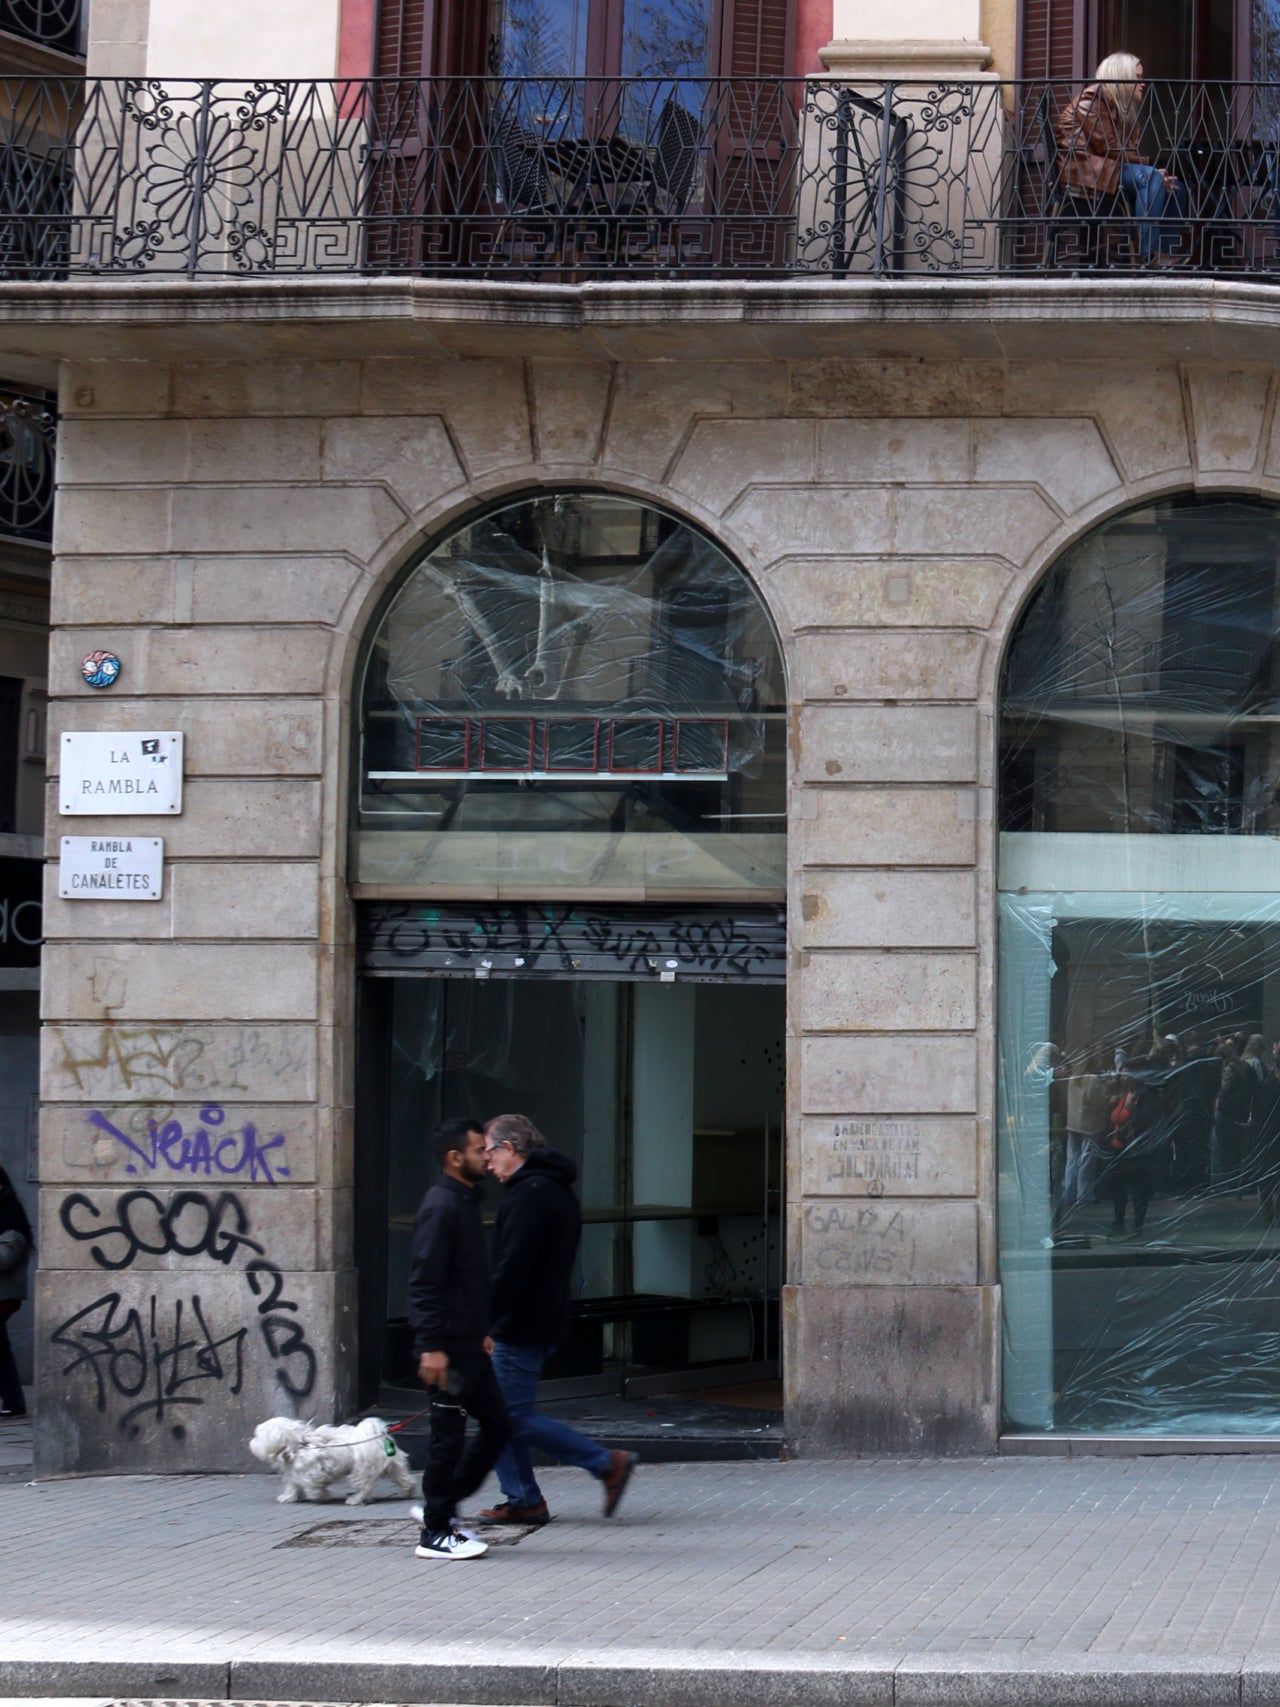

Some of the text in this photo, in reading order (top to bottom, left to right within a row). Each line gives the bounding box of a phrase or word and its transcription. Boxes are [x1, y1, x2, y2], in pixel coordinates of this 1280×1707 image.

[110, 751, 130, 763] LA
[82, 779, 158, 794] RAMBLA
[91, 841, 133, 853] RAMBLA
[104, 857, 117, 869] DE
